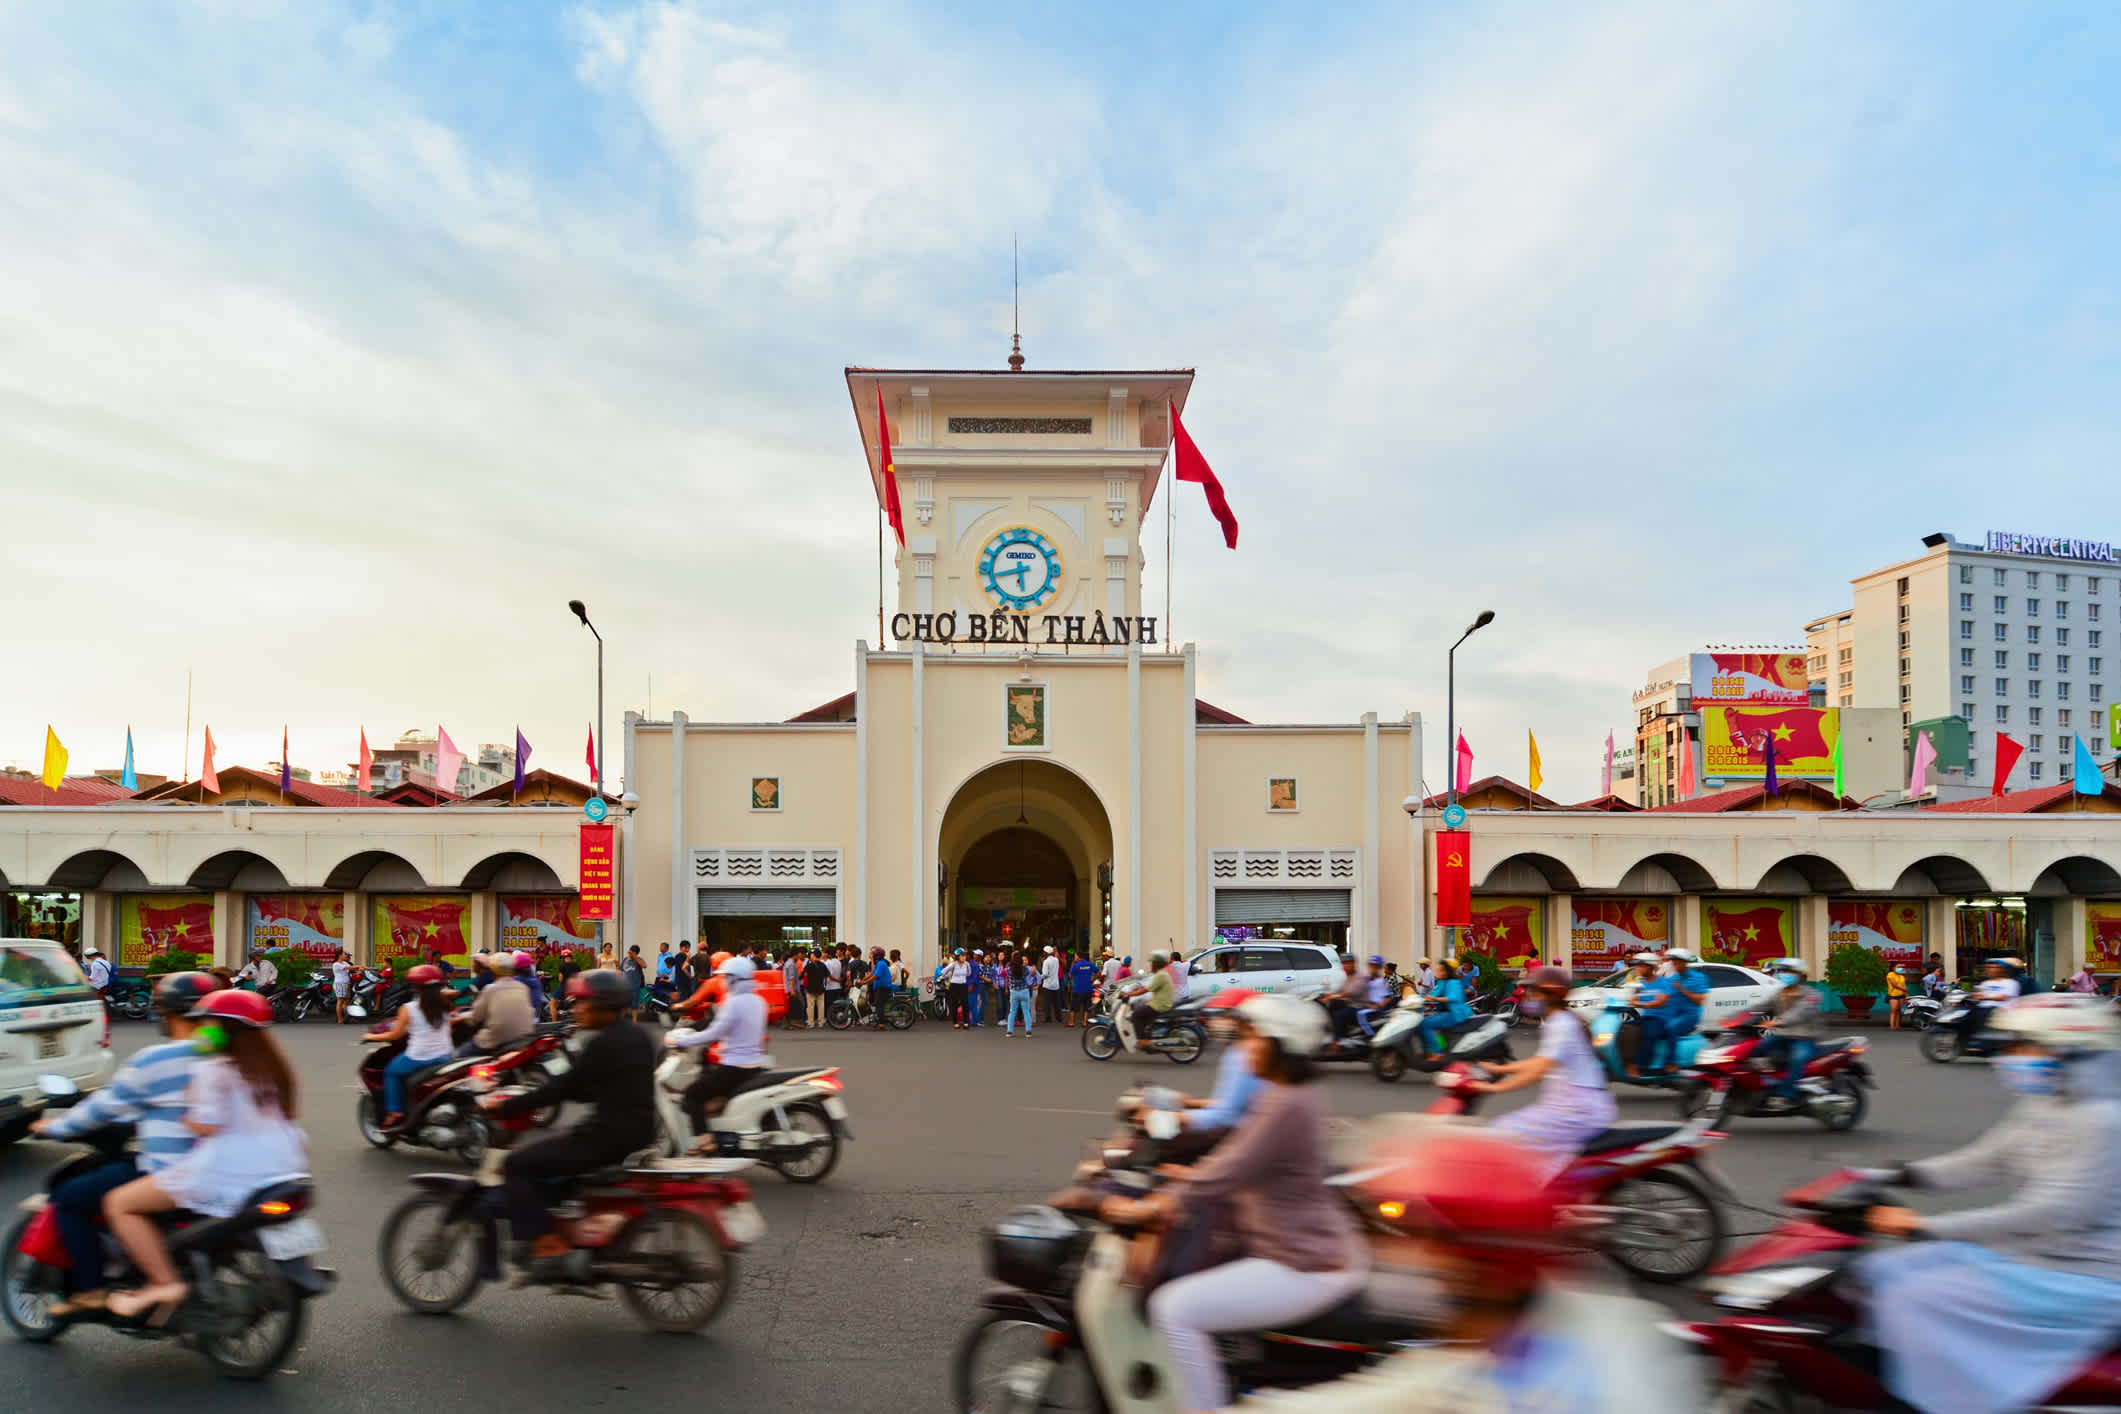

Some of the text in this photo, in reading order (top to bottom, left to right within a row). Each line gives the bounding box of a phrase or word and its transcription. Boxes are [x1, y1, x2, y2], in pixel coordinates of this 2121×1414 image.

[1006, 552, 1036, 560] GEMIKO
[1986, 529, 2119, 562] LIBERTY CENTRAL
[891, 605, 1157, 645] CHỢ BẾN THÀNH
